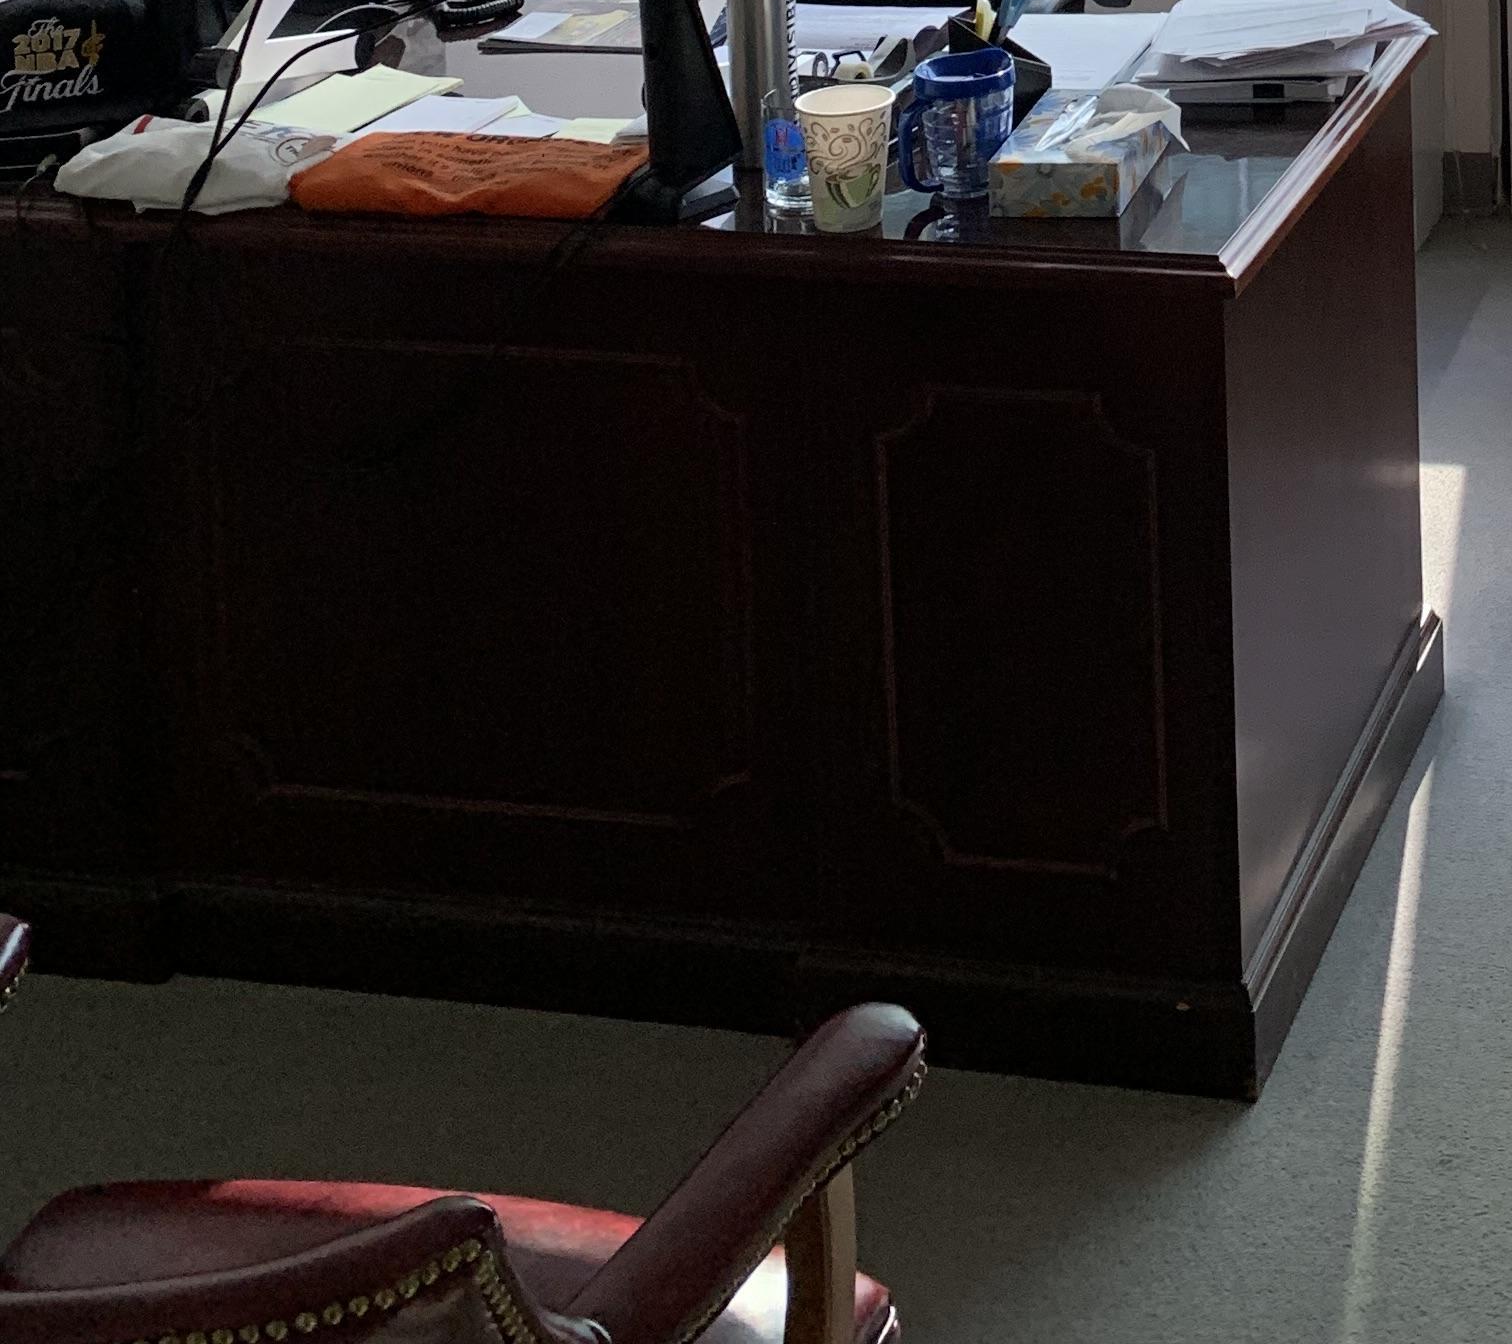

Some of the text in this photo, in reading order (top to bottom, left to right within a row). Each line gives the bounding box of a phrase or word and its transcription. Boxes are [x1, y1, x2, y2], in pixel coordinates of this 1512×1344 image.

[28, 16, 64, 39] The
[12, 28, 81, 55] 2017
[15, 49, 80, 71] NBA
[0, 63, 104, 113] Finals
